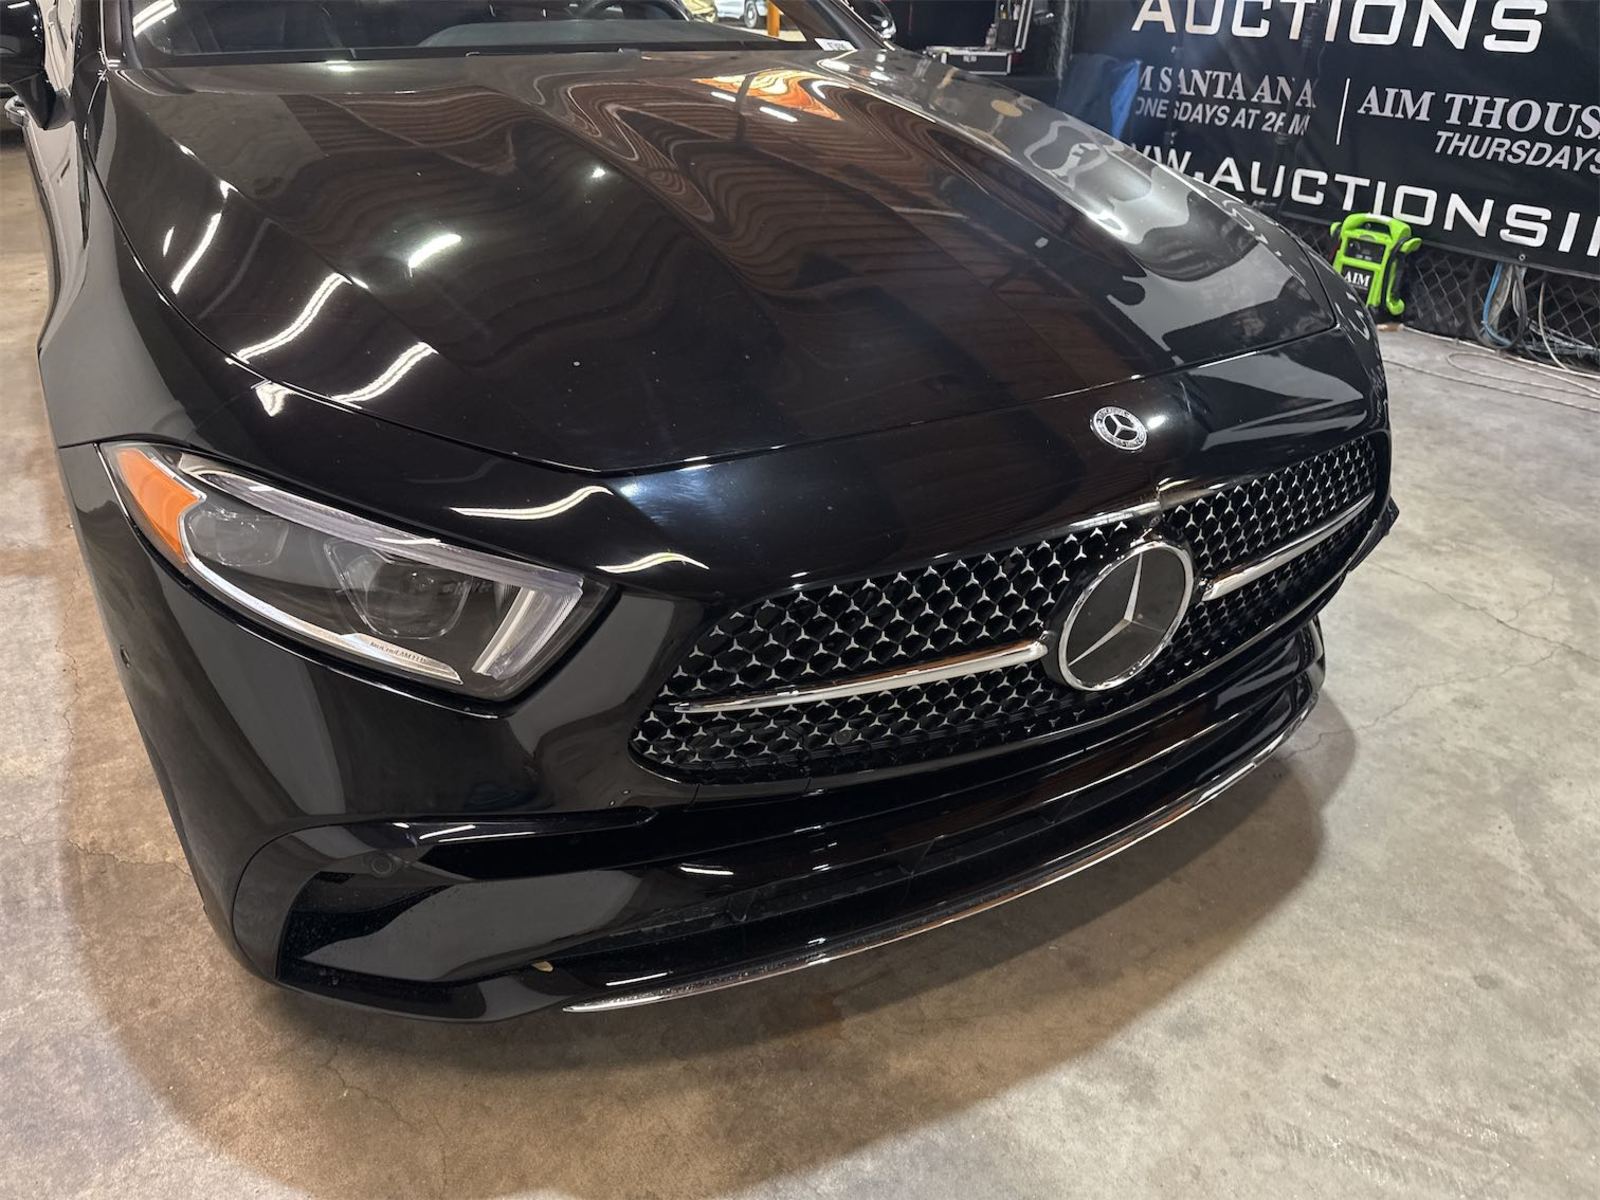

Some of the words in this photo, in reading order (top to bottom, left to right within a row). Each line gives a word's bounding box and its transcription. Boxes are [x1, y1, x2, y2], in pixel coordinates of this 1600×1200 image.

[1131, 0, 1548, 53] AUCTIONS
[1159, 66, 1246, 101] SANTA
[1231, 107, 1261, 130] AT
[1357, 85, 1436, 122] AIM
[1444, 92, 1600, 140] THOUS
[1344, 270, 1371, 288] AIM
